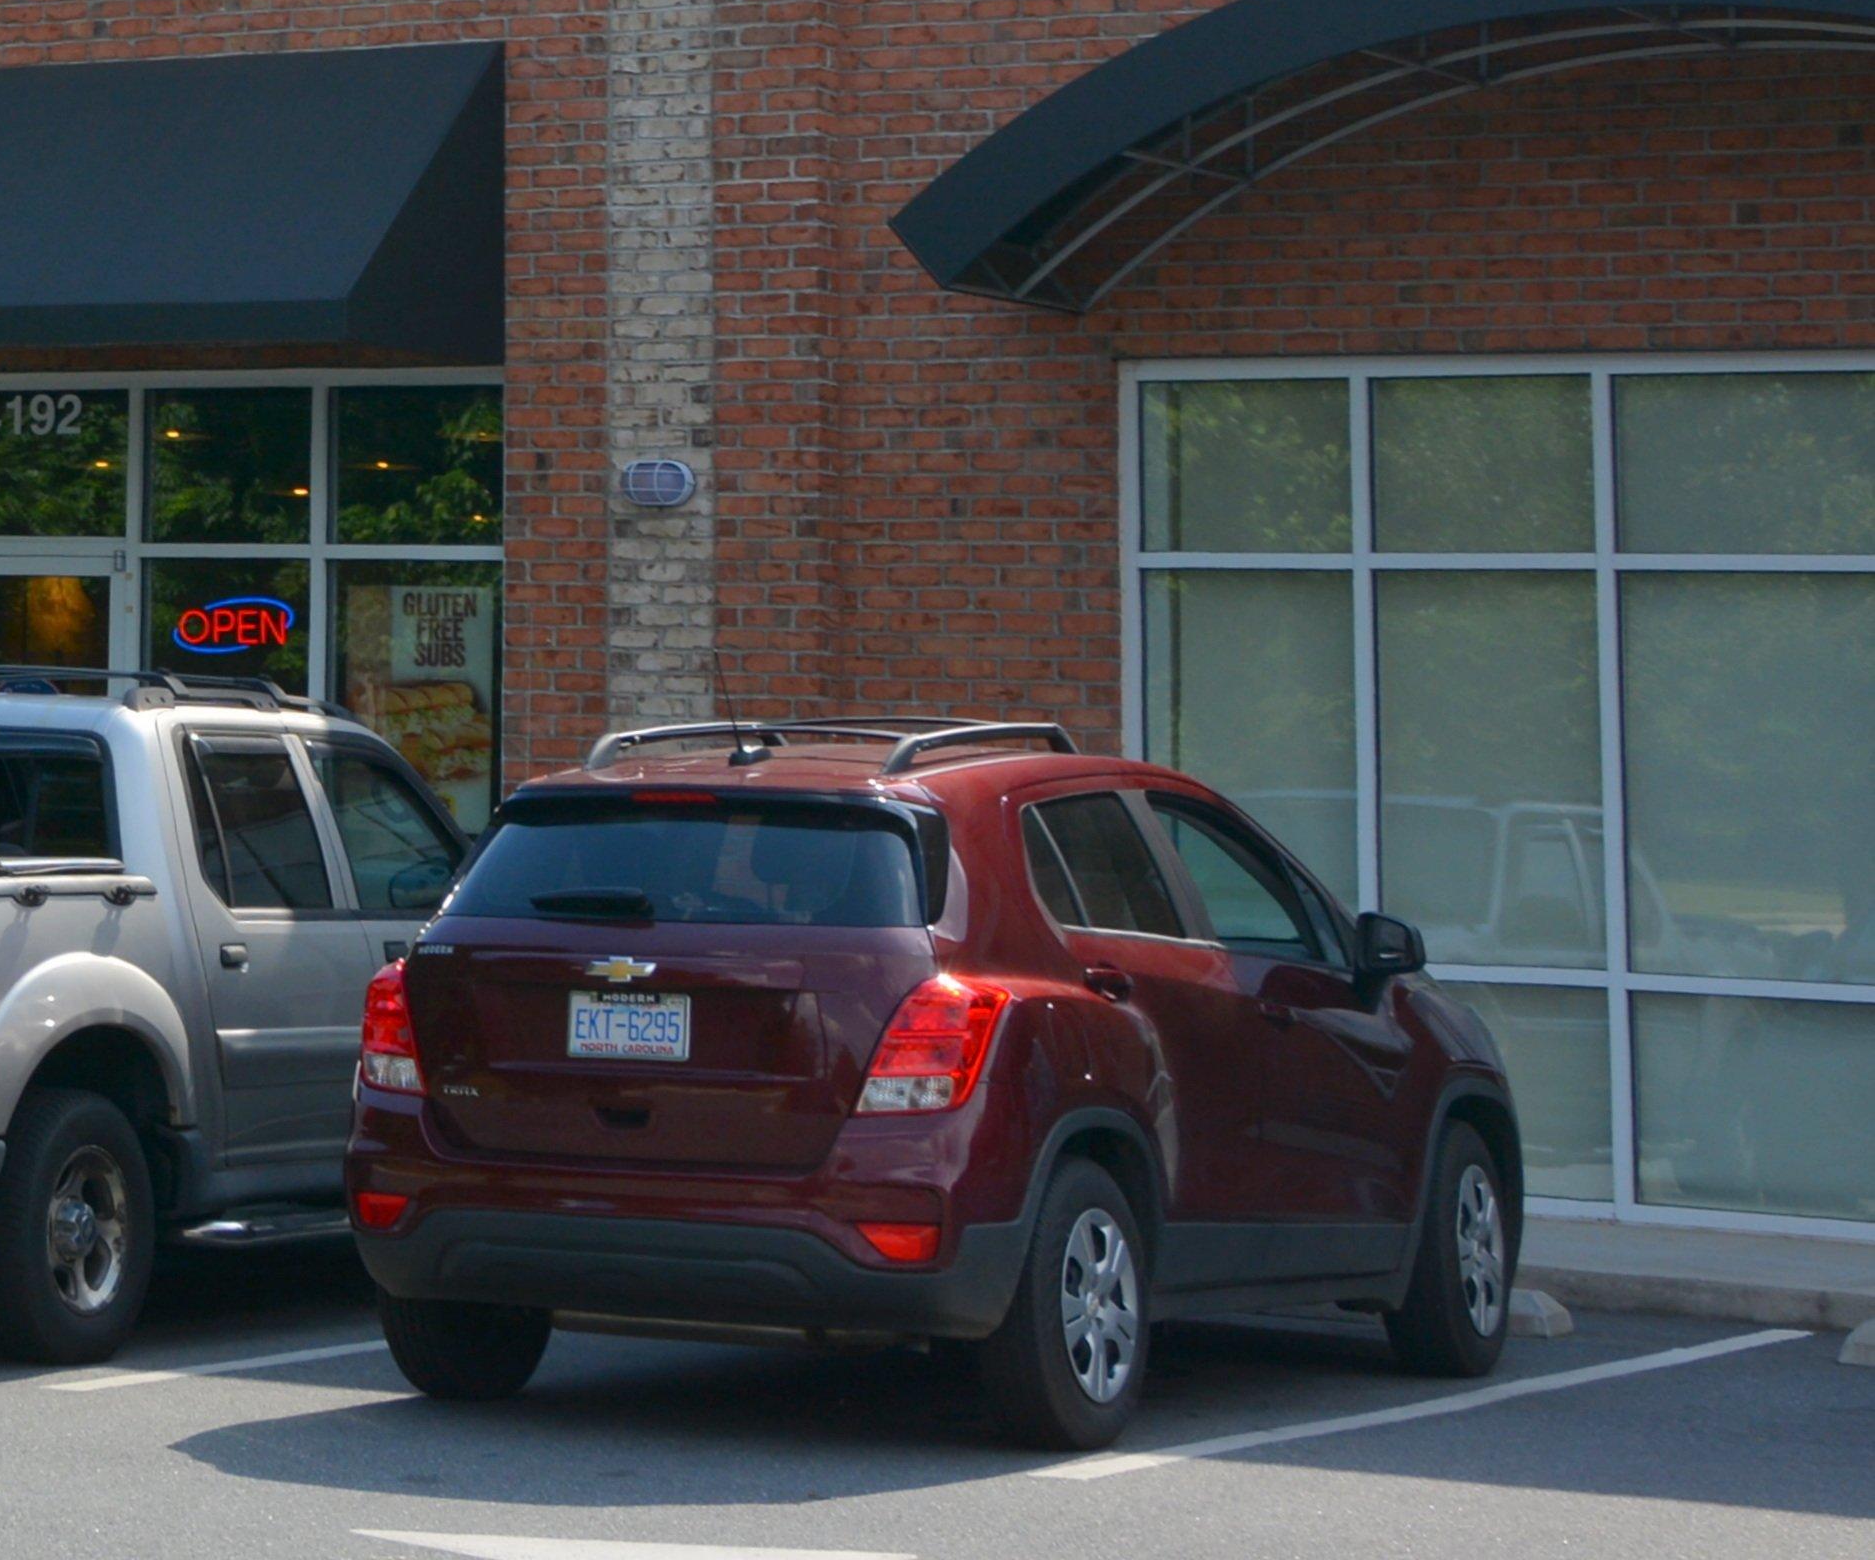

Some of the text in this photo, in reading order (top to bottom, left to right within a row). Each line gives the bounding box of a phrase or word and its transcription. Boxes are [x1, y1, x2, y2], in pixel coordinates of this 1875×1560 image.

[403, 592, 477, 618] GLUTEN
[177, 607, 288, 646] OPEN
[416, 617, 464, 643] FREE
[414, 642, 466, 668] SUBS
[602, 993, 656, 1003] MODERN
[575, 1008, 681, 1044] EKT-6295
[580, 1042, 676, 1055] NORTH CAROLINA
